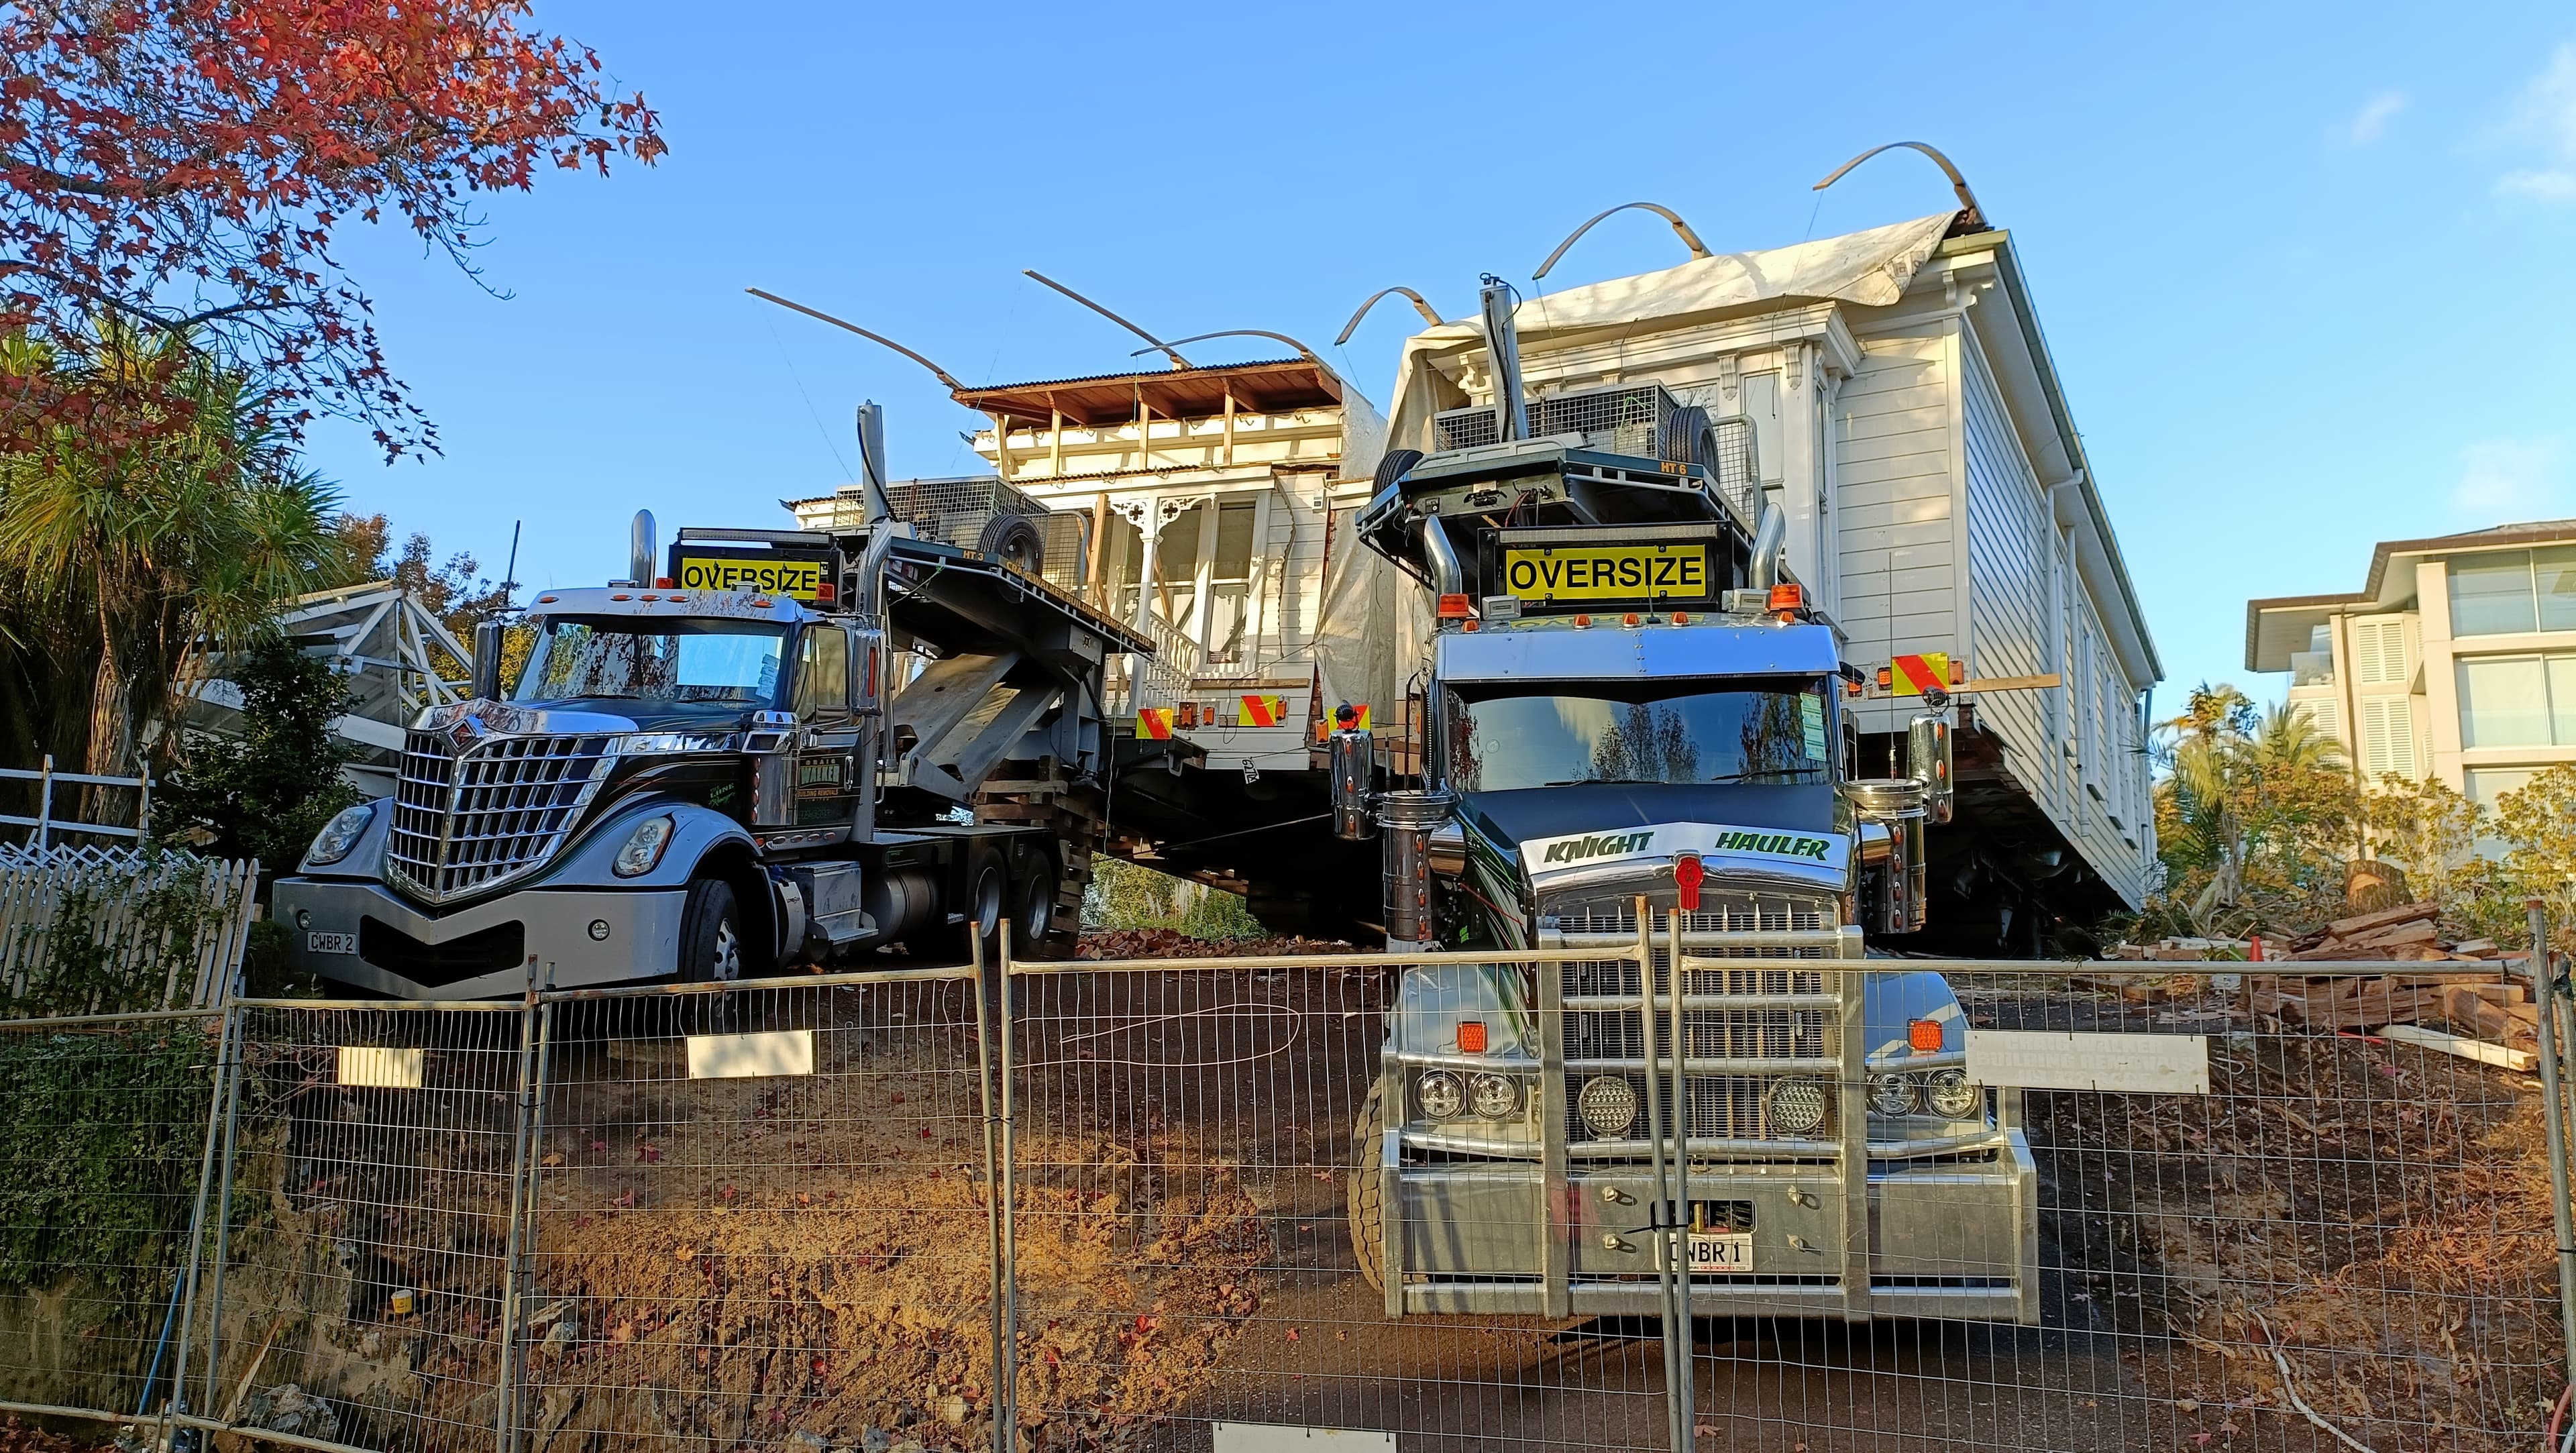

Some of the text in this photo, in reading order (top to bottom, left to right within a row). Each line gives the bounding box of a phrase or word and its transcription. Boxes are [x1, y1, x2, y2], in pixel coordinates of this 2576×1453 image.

[1660, 462, 1687, 474] HT 6
[963, 550, 984, 561] HT 3
[684, 566, 816, 592] OVERSIZE
[1510, 556, 1702, 590] OVERSIZE
[1032, 576, 1065, 599] WALKER
[1066, 594, 1100, 620] BUILDING
[1101, 613, 1137, 639] REMOVALS
[1137, 635, 1150, 647] LTD
[1544, 832, 1831, 863] KNIGHT HAULER
[311, 934, 353, 951] CWBR 2
